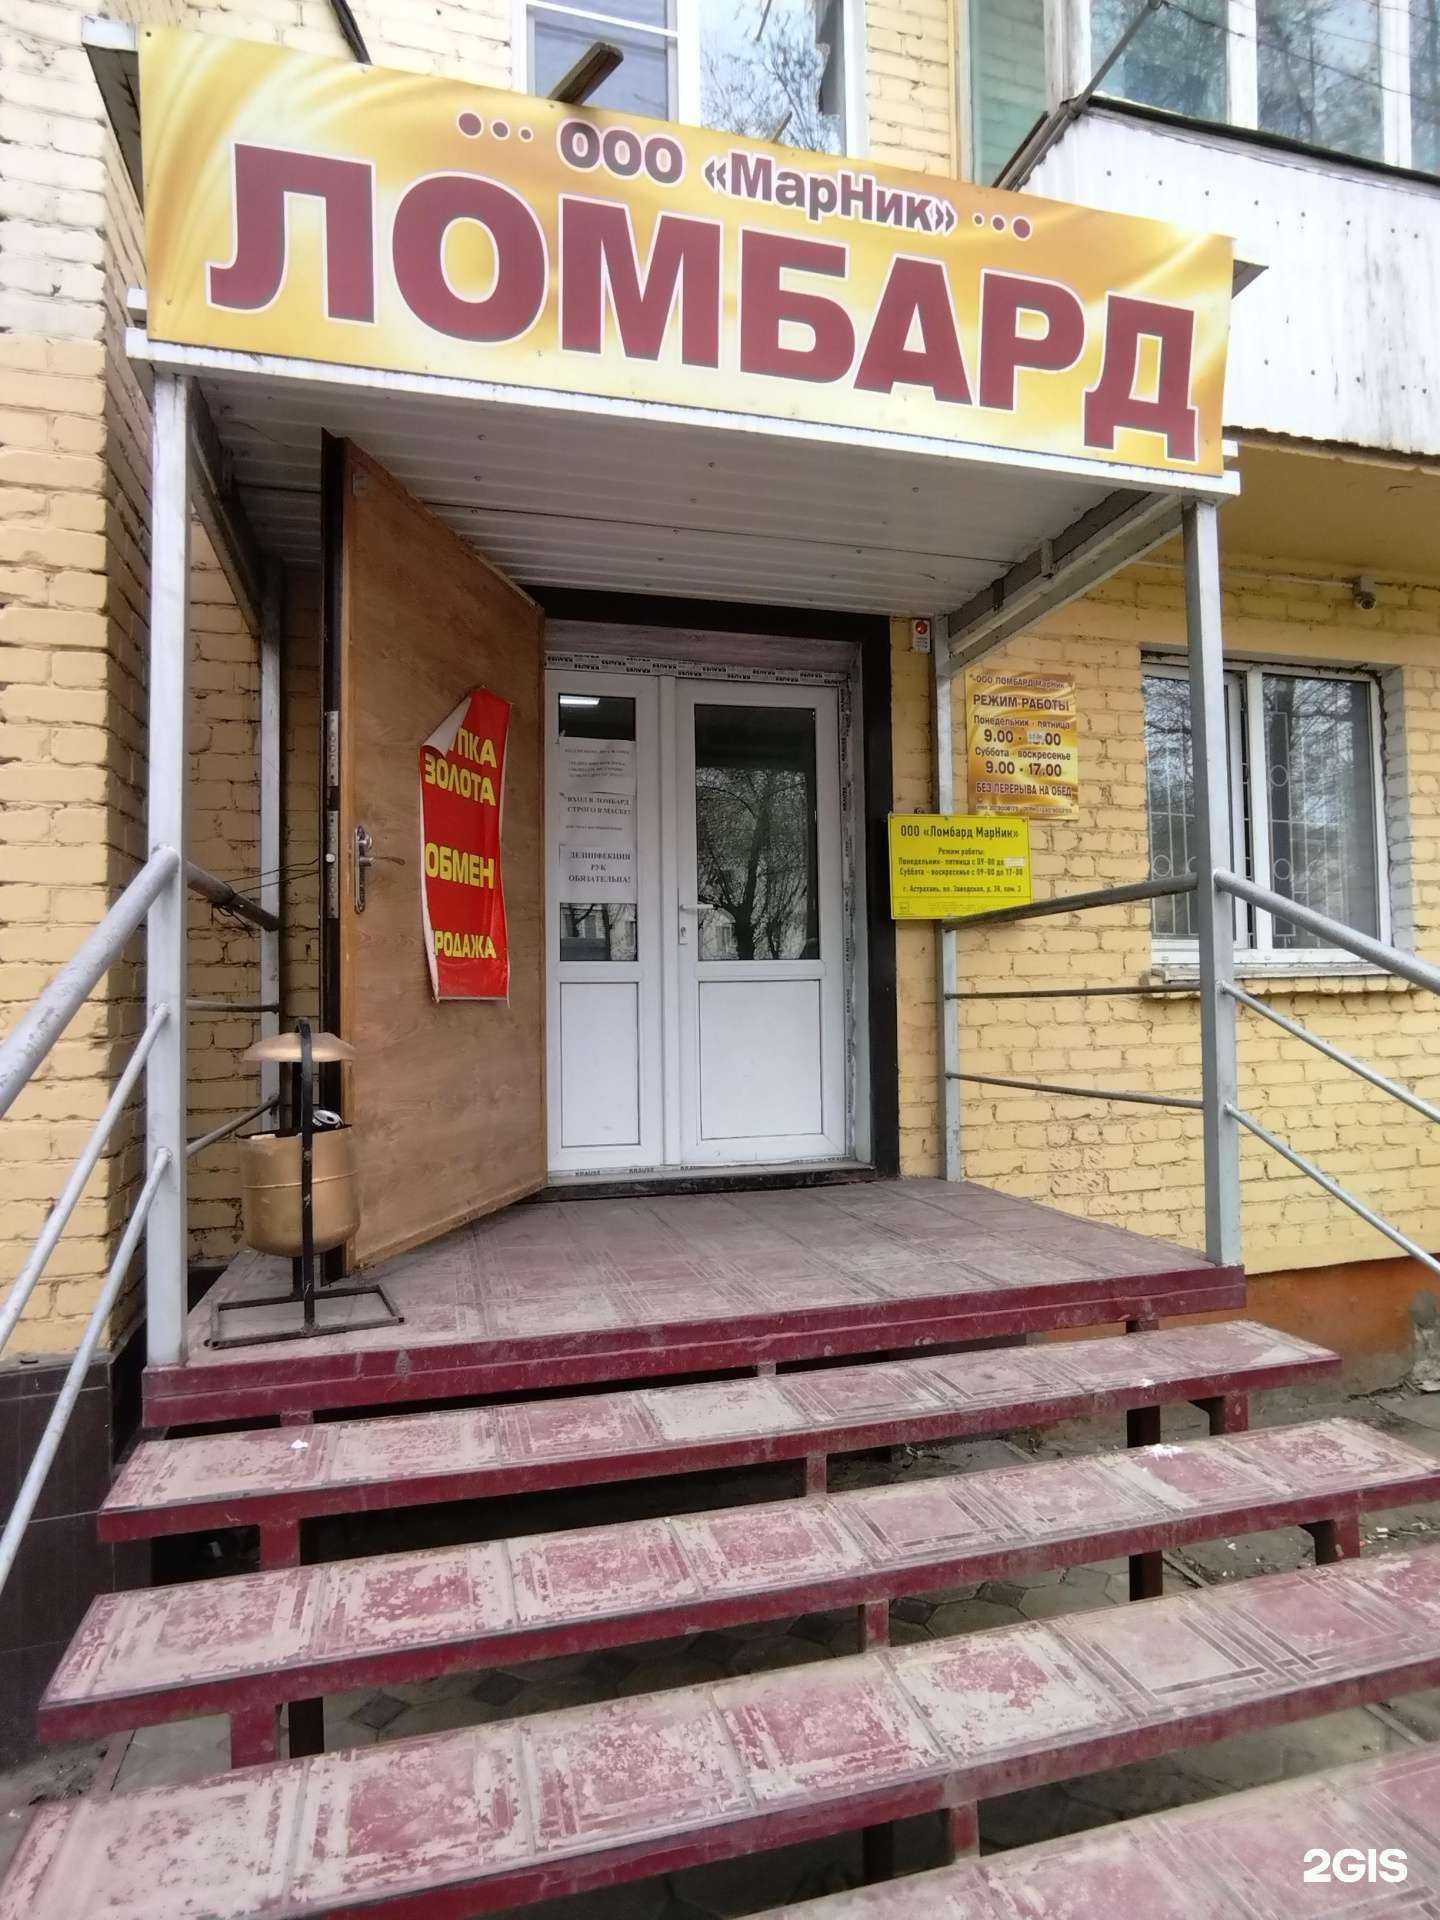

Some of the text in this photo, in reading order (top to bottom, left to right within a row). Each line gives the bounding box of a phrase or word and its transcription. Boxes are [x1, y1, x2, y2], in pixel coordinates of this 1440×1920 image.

[558, 120, 956, 233] ООО «МарНик»
[208, 142, 1198, 464] ЛОМБАРД
[976, 675, 993, 683] ООО
[973, 694, 1070, 711] РЕЖИМ РАБОТЫ
[974, 715, 1029, 727] Понедельник
[1038, 721, 1070, 730] пятница
[984, 729, 1014, 743] 9.00
[975, 747, 1009, 757] Суббота
[1018, 751, 1071, 760] воскресенье
[986, 761, 1015, 774] 9.00
[1028, 763, 1062, 777] 17.00
[424, 753, 496, 806] ЗОЛОТА
[976, 783, 1072, 797] БЕЗ ПЕРЕРЫВА НА ОБЕД
[901, 825, 1019, 839] ООО «Ломбард МарНик»
[424, 842, 495, 890] ОБМЕН
